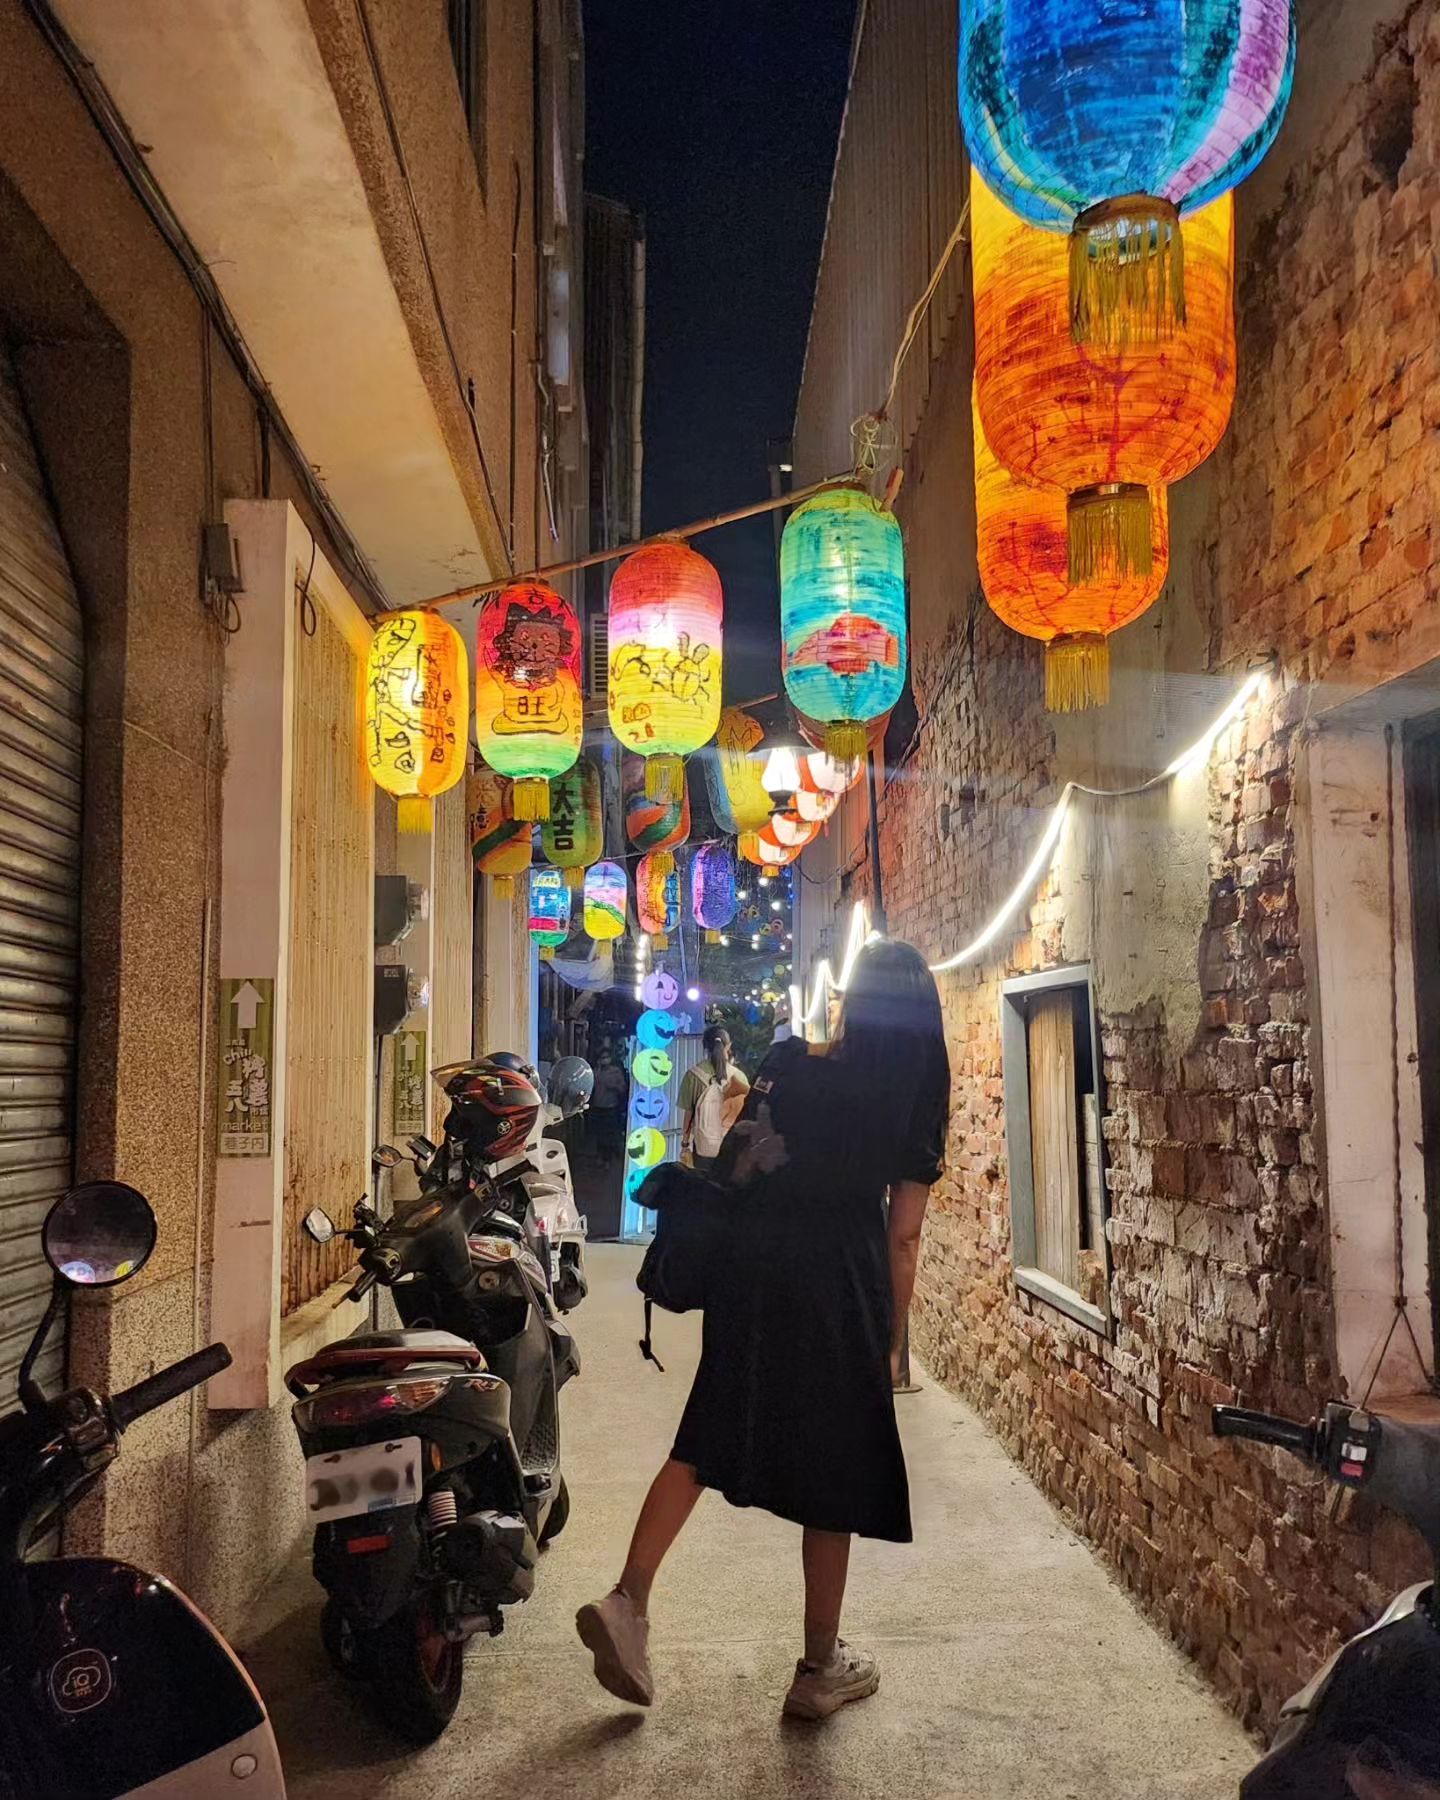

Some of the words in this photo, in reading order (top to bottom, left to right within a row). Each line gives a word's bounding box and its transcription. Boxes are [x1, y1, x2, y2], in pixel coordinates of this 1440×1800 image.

[517, 695, 546, 716] 旺
[553, 783, 576, 851] 大吉
[221, 1118, 268, 1132] market
